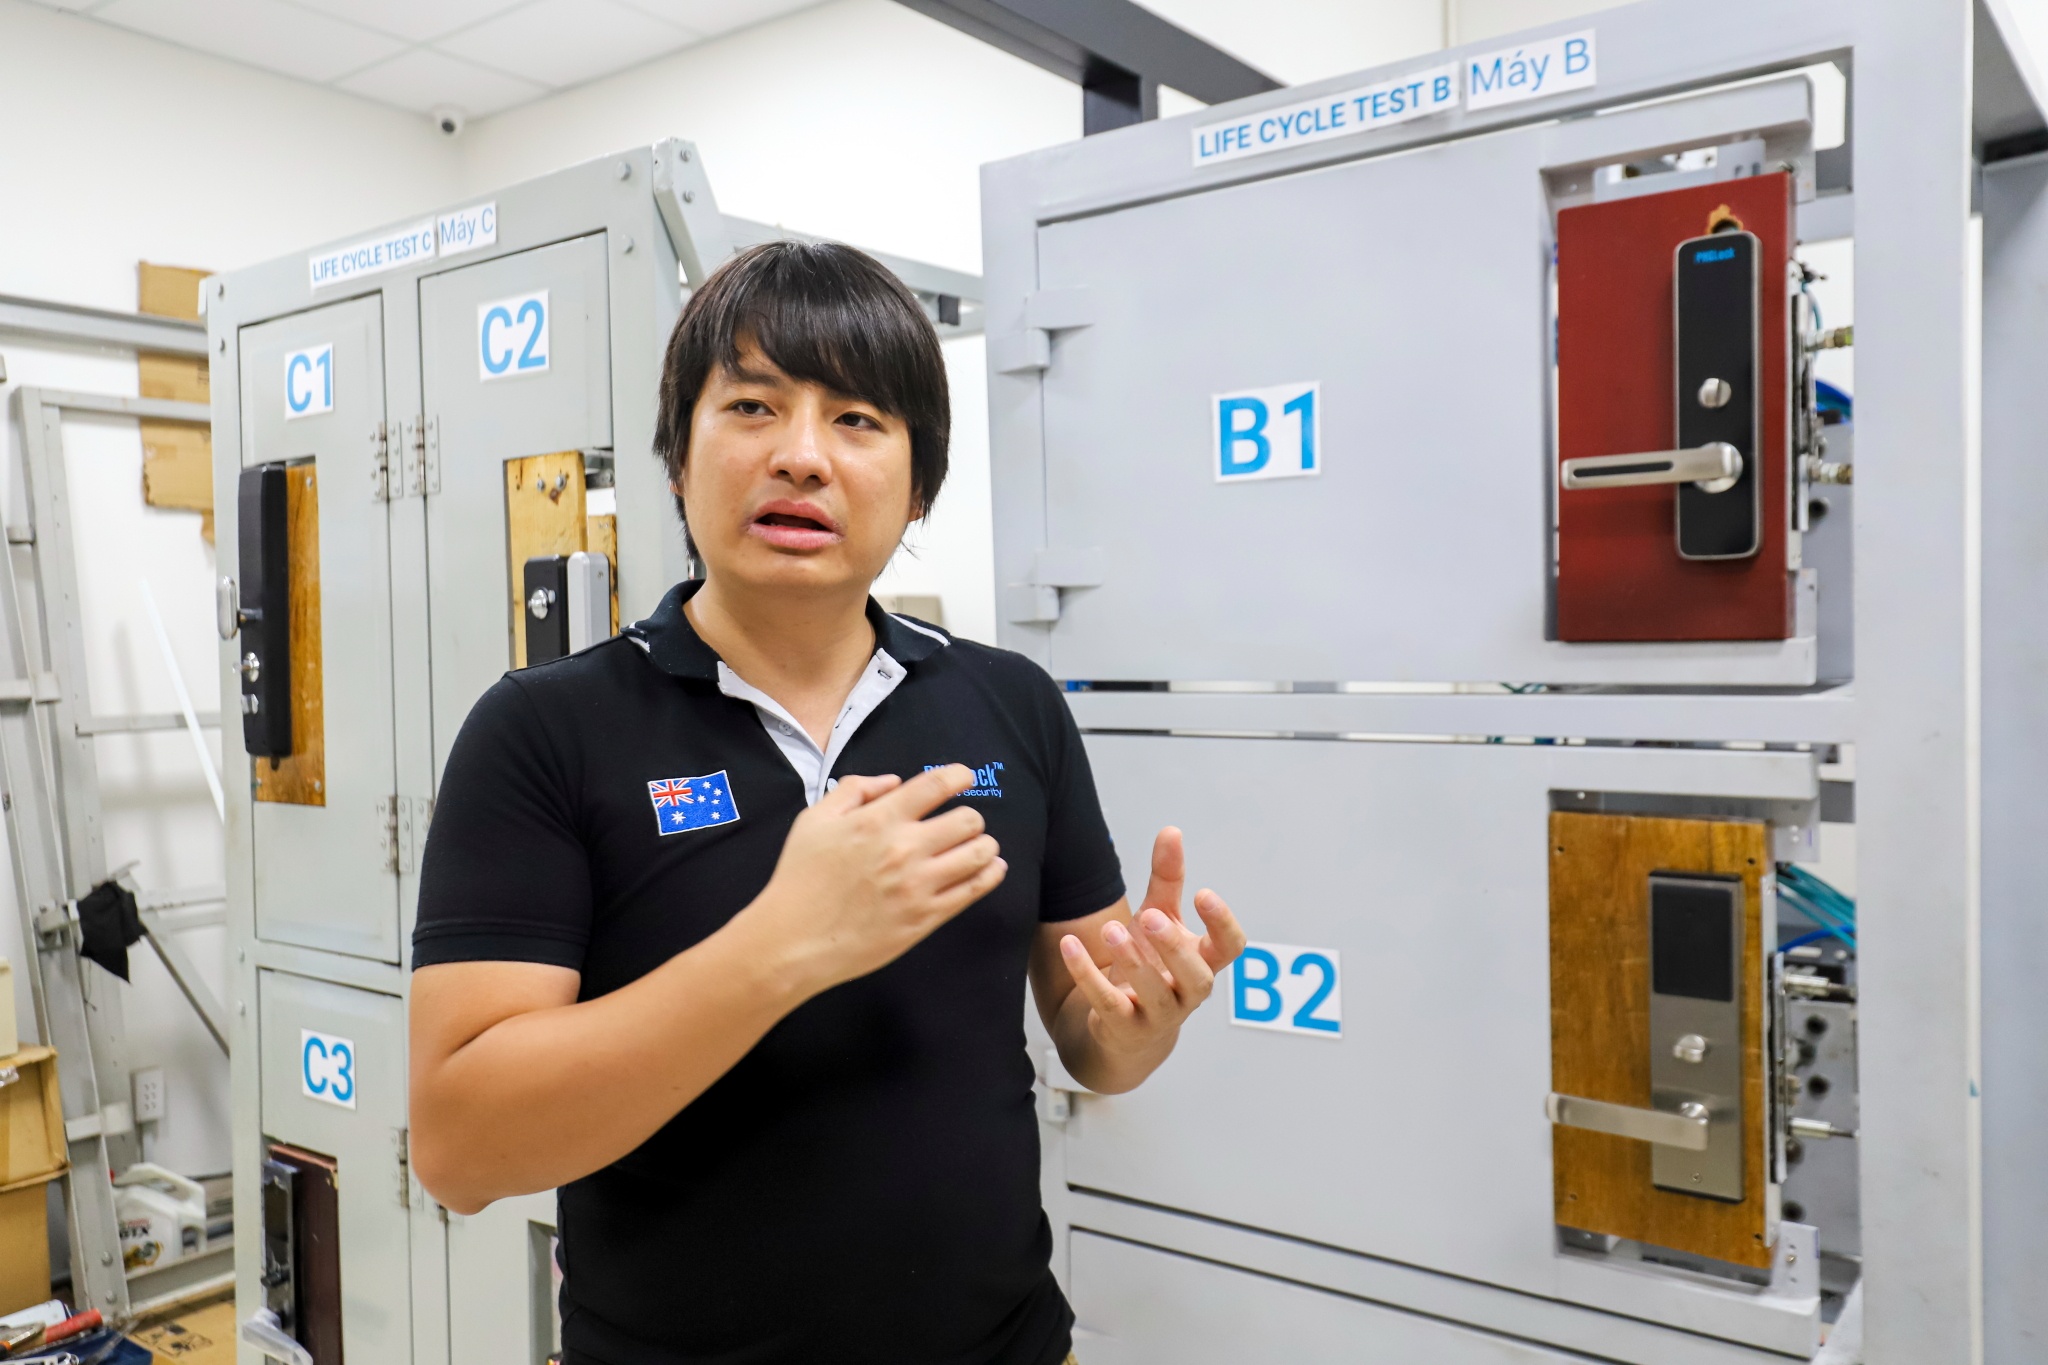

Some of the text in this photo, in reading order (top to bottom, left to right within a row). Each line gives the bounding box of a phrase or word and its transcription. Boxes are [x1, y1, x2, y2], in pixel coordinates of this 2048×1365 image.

[1471, 38, 1591, 95] Máy B
[1200, 75, 1451, 157] LIFE CYCLE TEST B
[312, 230, 432, 282] LIFE CYCLE TEST C
[440, 207, 494, 246] Máy C
[481, 299, 547, 375] C2
[286, 348, 333, 413] C1
[1219, 389, 1314, 476] B1
[963, 787, 1002, 798] Security
[1233, 946, 1340, 1033] B2
[303, 1036, 353, 1101] C3
